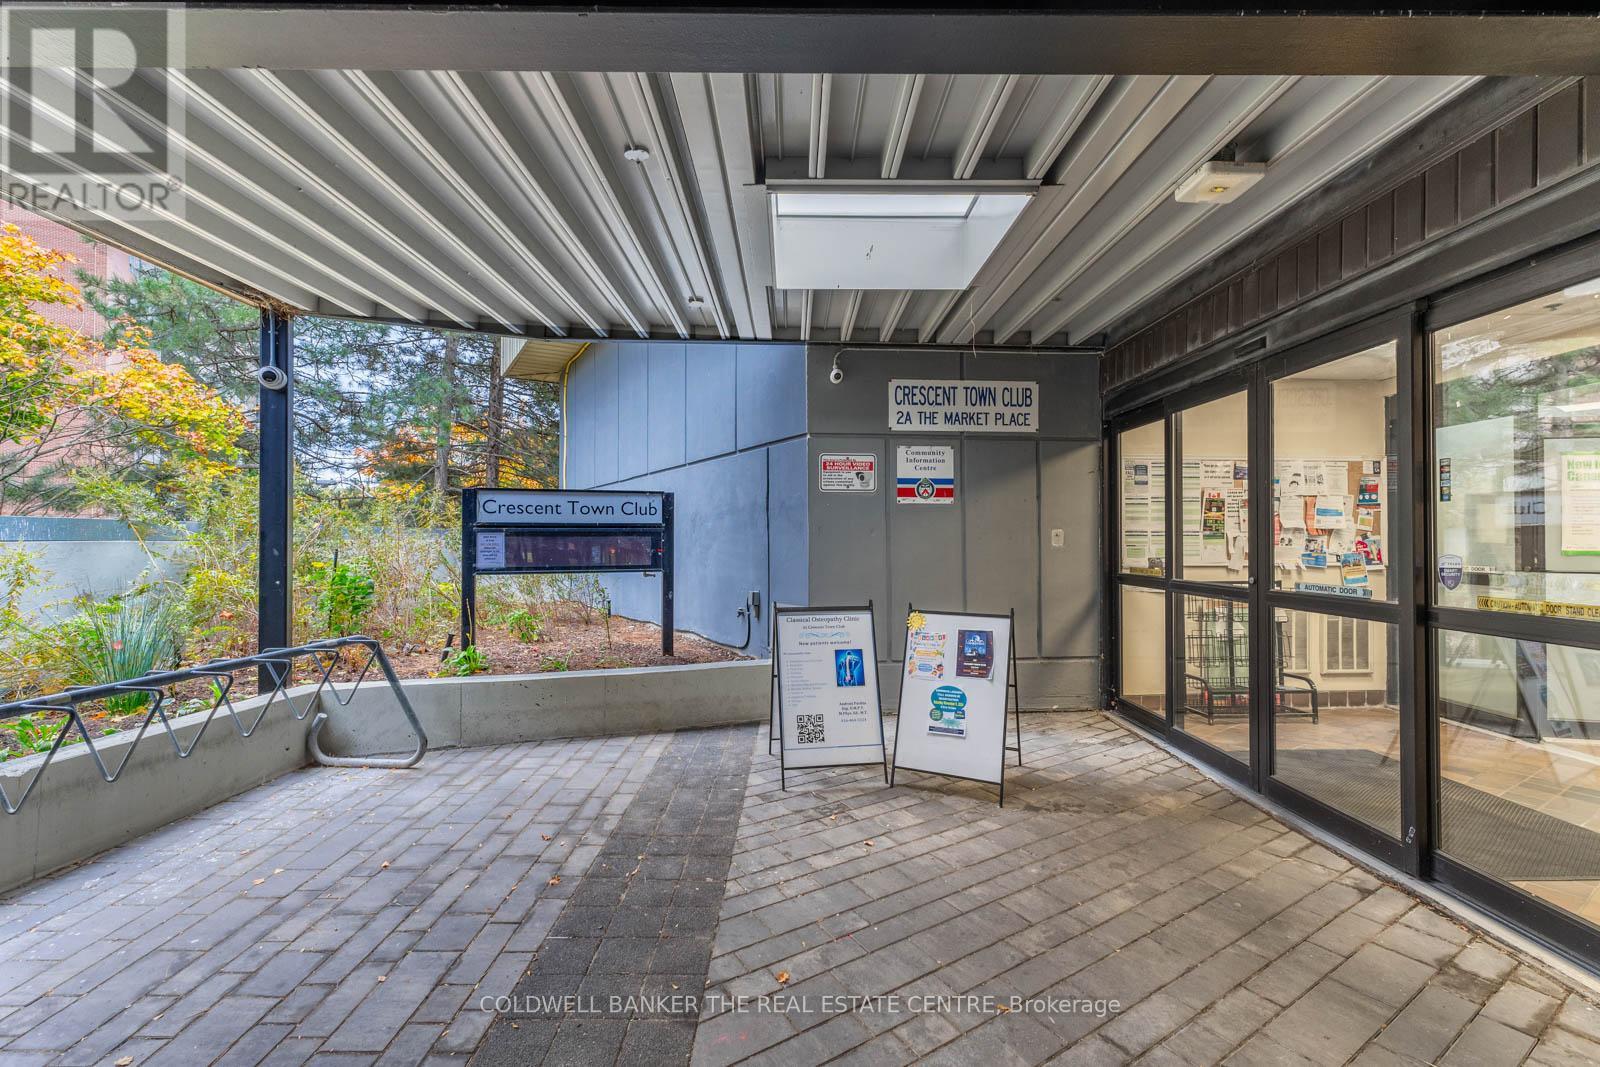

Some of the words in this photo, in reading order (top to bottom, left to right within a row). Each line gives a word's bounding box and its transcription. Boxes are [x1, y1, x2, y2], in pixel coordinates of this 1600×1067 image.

[894, 385, 958, 406] CRESCENT
[963, 386, 996, 407] TOWN
[1002, 387, 1032, 407] CLUB
[896, 411, 912, 425] 2A
[917, 411, 939, 425] THE
[944, 412, 990, 426] MARKET
[995, 413, 1031, 426] PLACE
[905, 449, 945, 457] Community
[482, 499, 562, 515] Crescent
[567, 500, 614, 516] Town
[621, 501, 657, 517] Club
[1304, 584, 1337, 593] AUTOMATIC
[1339, 587, 1358, 595] DOOR
[1546, 604, 1562, 614] DOOR
[1566, 606, 1584, 616] STAND
